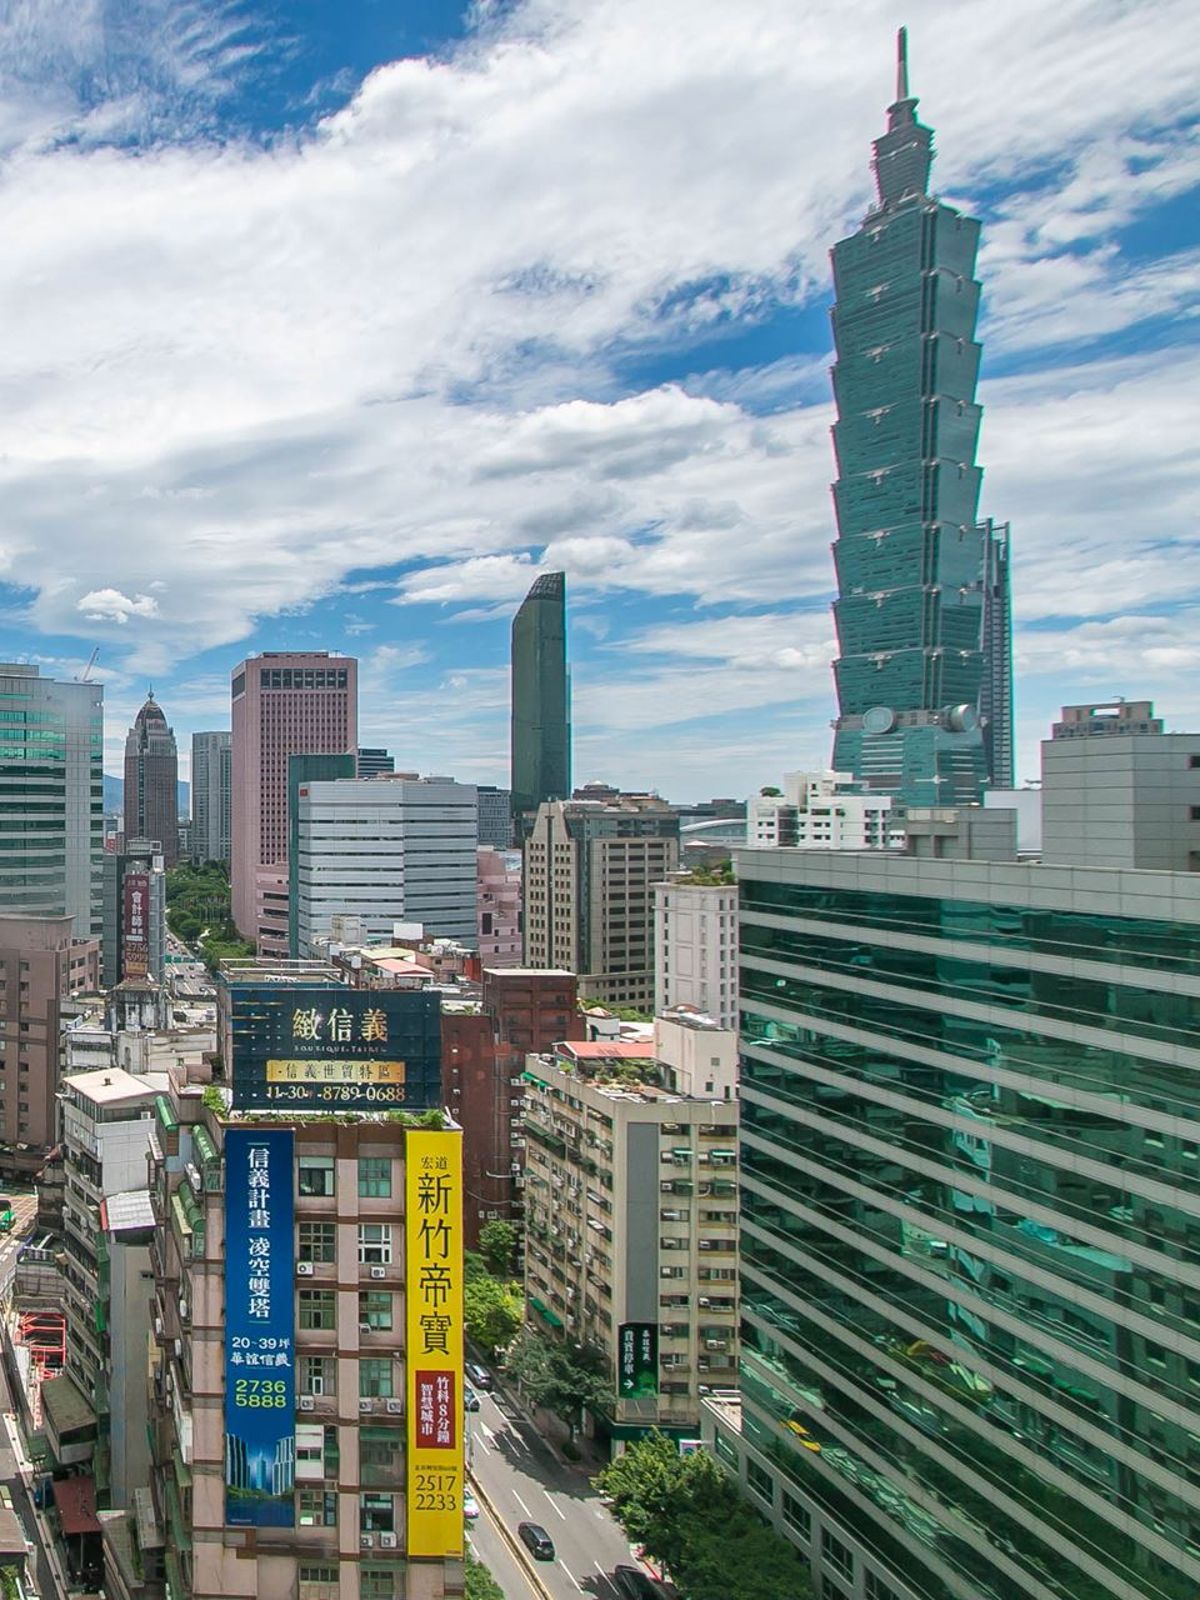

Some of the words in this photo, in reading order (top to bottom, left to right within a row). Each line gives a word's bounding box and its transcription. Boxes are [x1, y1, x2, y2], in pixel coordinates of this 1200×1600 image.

[292, 1007, 388, 1041] 緻信義
[286, 1063, 390, 1080] 信義世貿特區
[323, 1085, 405, 1101] 8789-0688
[421, 1156, 448, 1170] 宏道
[247, 1148, 270, 1229] 信義計畫
[417, 1173, 453, 1355] 新竹帝寶
[247, 1236, 270, 1318] 凌空雙塔
[236, 1379, 286, 1393] 2736
[235, 1393, 287, 1408] 5888
[420, 1383, 434, 1436] 智慧城市
[436, 1376, 450, 1444] 竹科8分鐘
[415, 1474, 457, 1491] 2517
[415, 1493, 457, 1511] 2233
